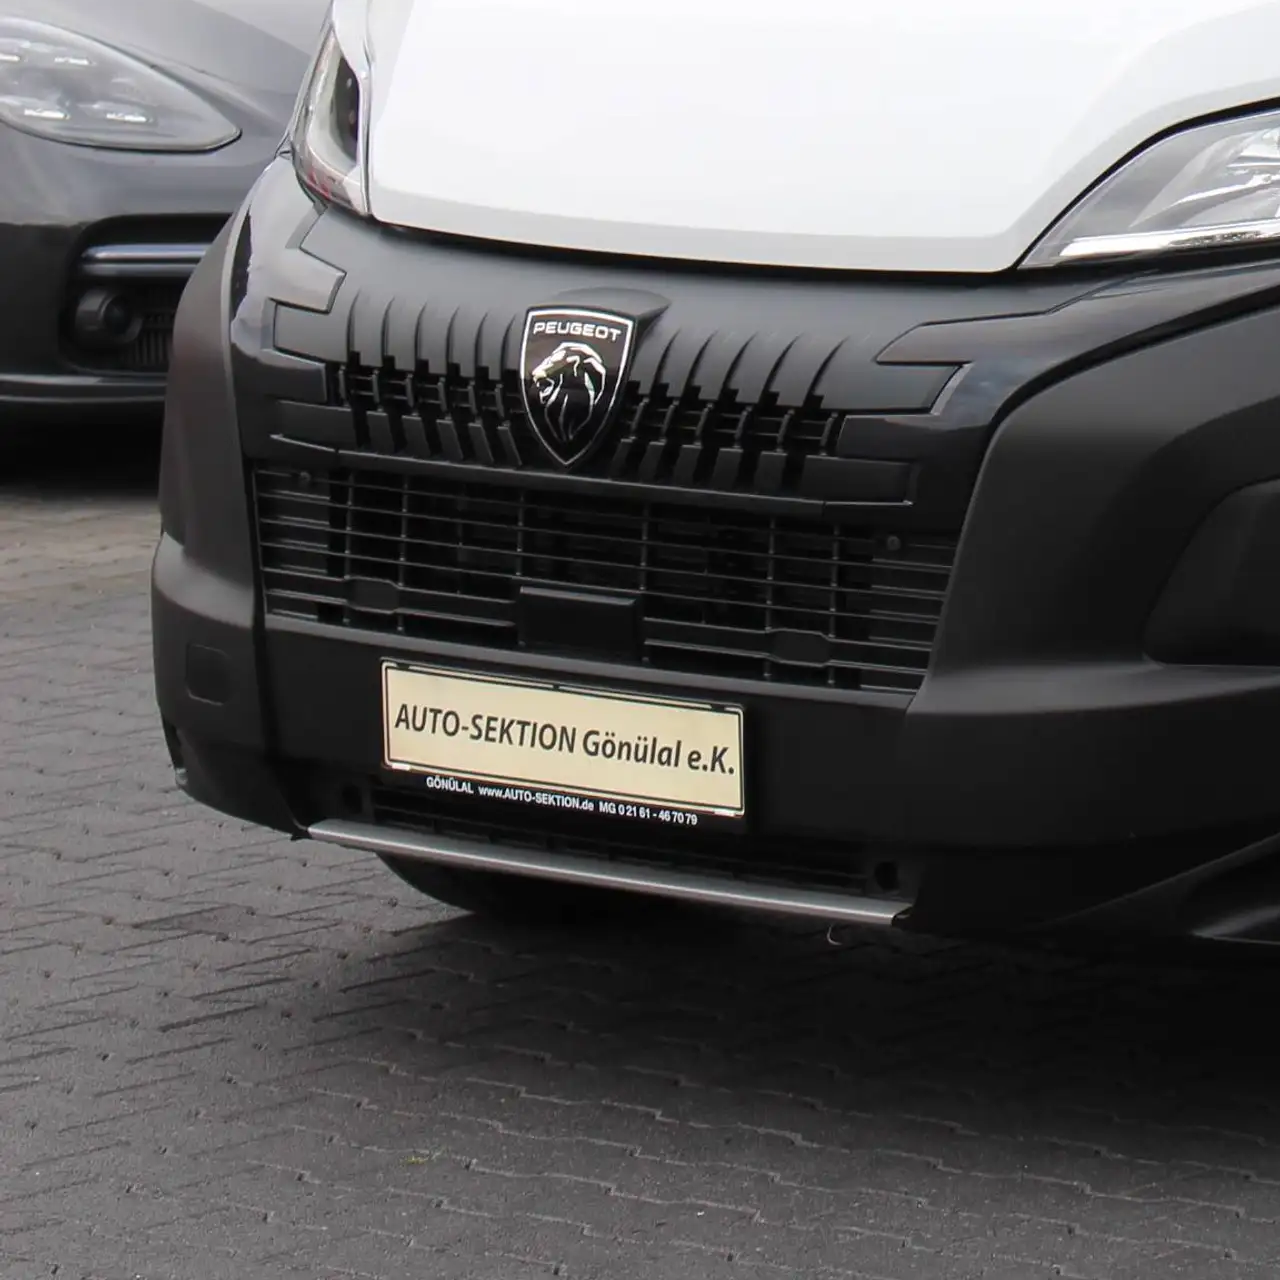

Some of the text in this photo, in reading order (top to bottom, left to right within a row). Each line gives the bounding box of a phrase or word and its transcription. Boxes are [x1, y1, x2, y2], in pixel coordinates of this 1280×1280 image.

[533, 321, 623, 342] PEUGEOT
[394, 703, 735, 775] AUTO-SEKTION Gönülal e.K.
[426, 775, 474, 794] GÖNÜLAL
[478, 785, 595, 811] www.AUTO-SEKTION.de
[598, 800, 617, 815] MG
